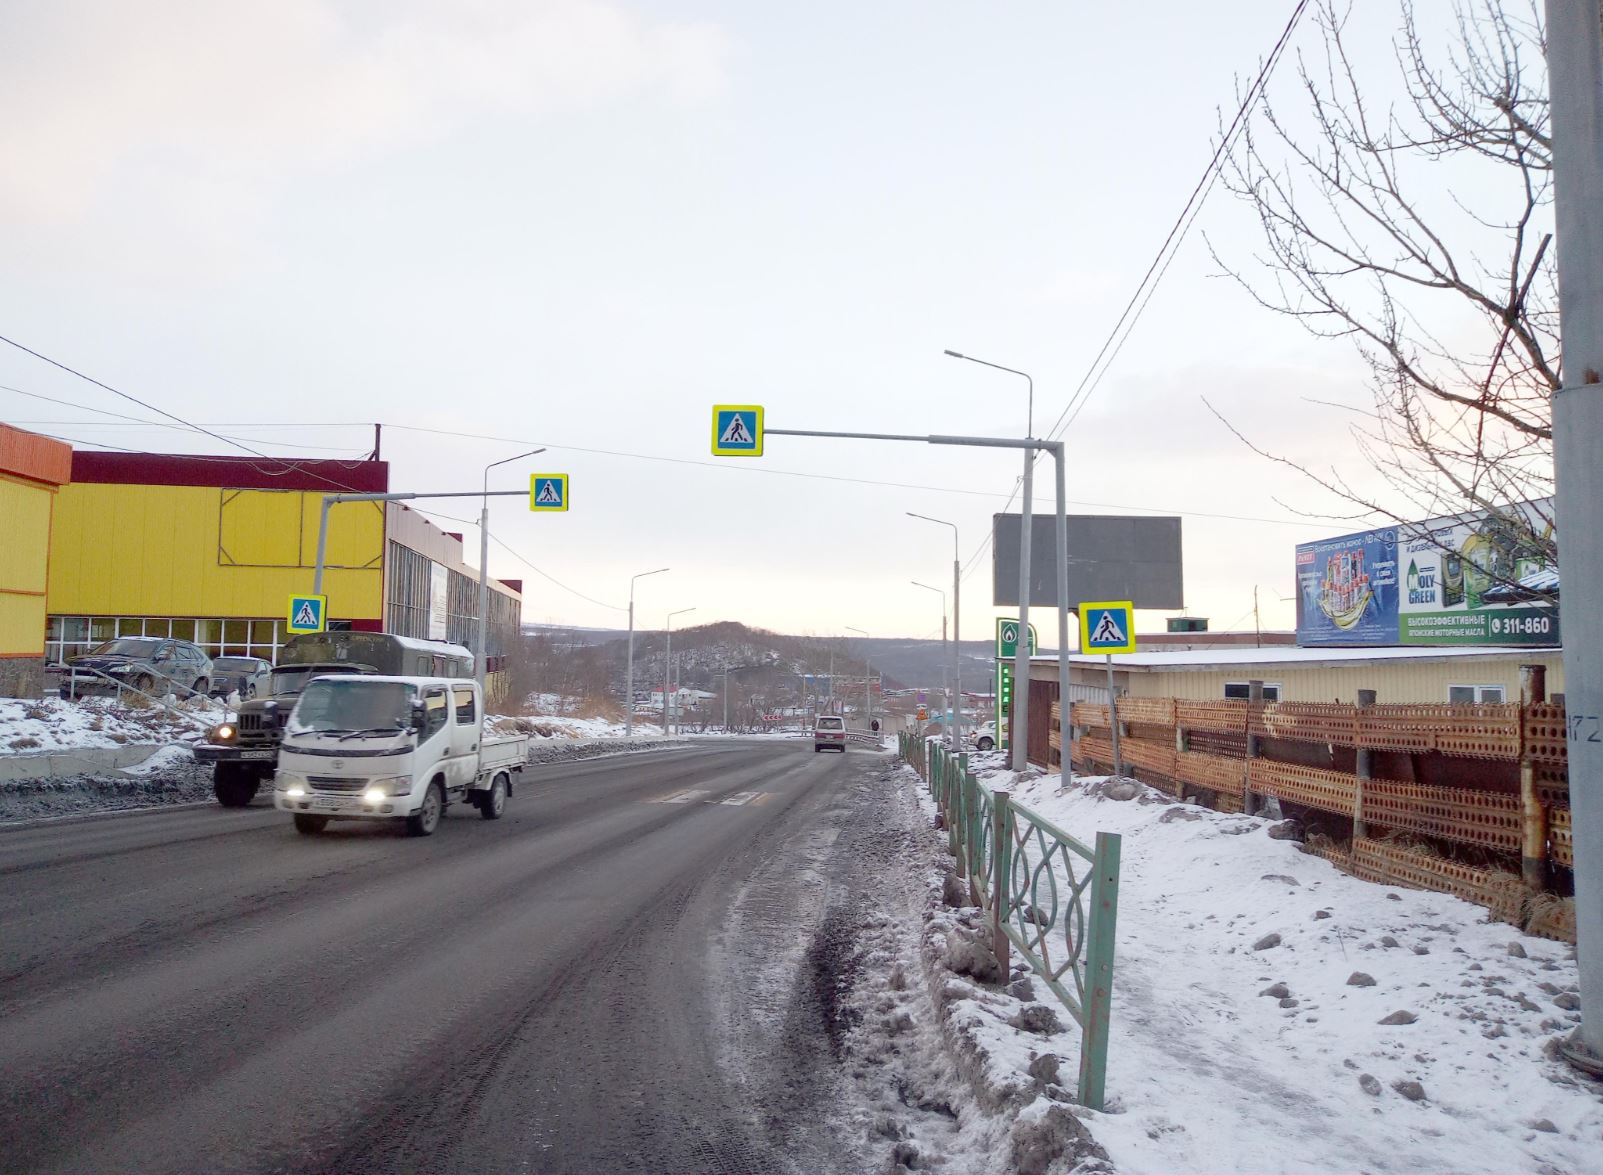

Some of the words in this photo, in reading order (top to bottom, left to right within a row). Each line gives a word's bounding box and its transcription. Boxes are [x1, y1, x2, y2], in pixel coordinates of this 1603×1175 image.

[1407, 574, 1435, 589] MOLY
[1409, 590, 1435, 603] GREEN
[1408, 615, 1485, 626] ВЫСОКОЭФФЕКТИВНЫЕ
[1503, 617, 1549, 634] 311-860
